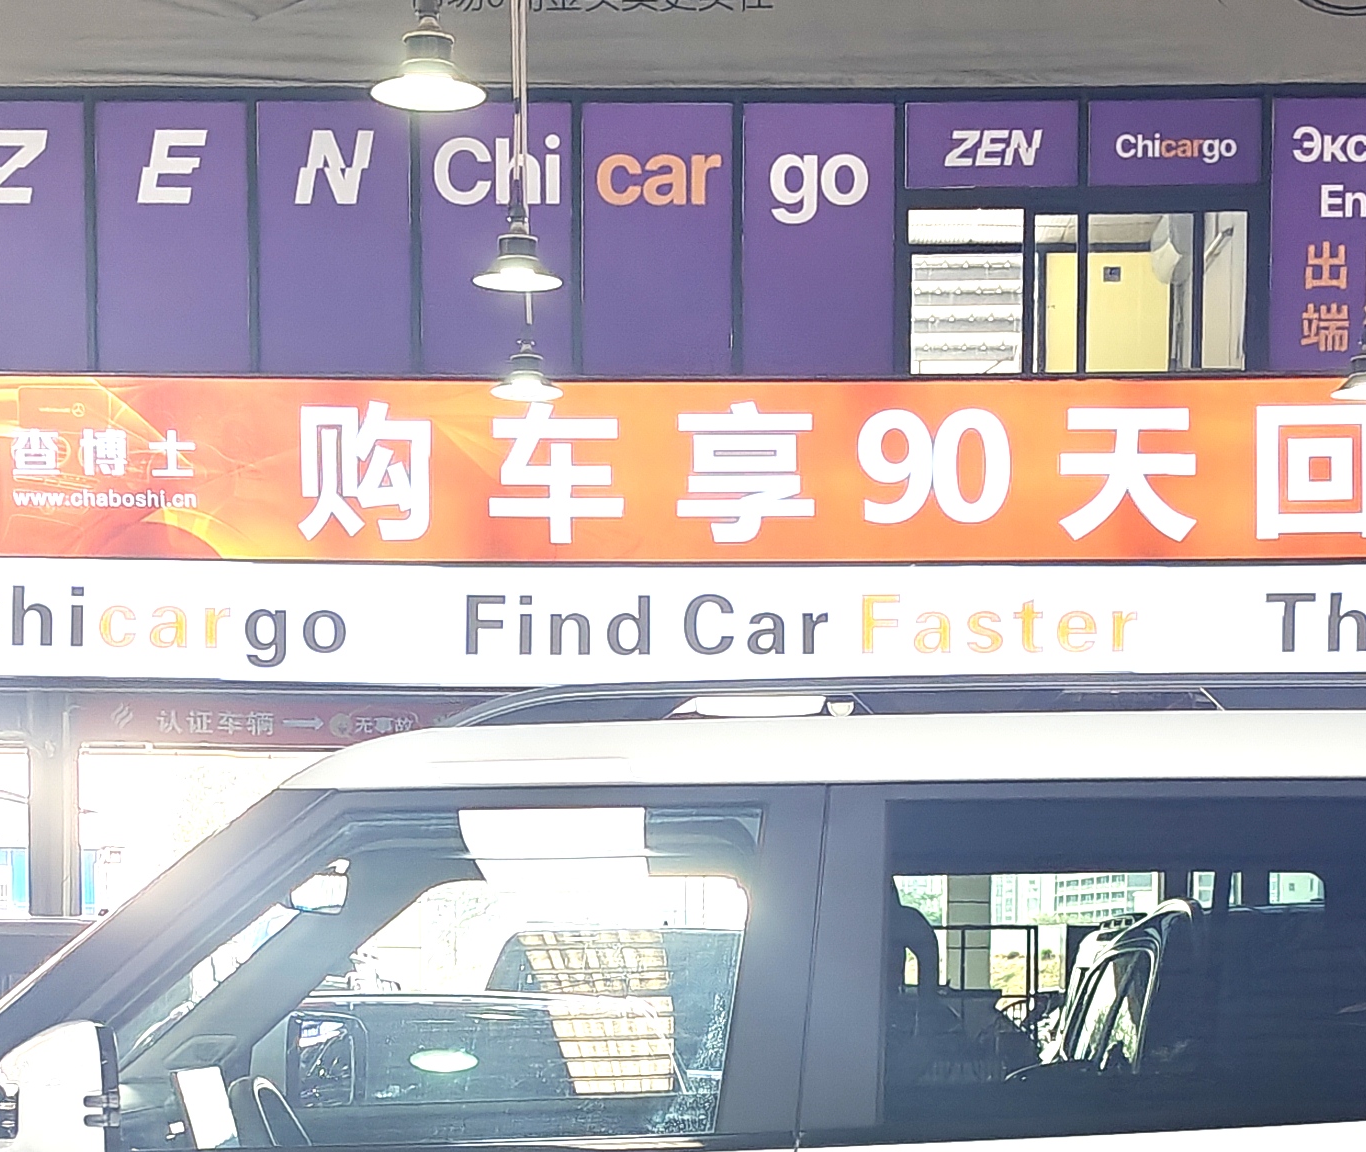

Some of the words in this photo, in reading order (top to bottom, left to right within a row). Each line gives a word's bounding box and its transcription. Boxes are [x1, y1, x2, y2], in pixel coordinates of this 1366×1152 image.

[944, 129, 1044, 167] ZEN
[1115, 133, 1238, 165] Chicargo
[433, 134, 562, 206] Chi
[596, 152, 722, 206] car
[769, 153, 870, 225] go
[11, 428, 196, 478] 查博士
[12, 489, 197, 509] www.chaboshi.cn
[465, 594, 651, 656] Find
[683, 594, 829, 656] Car
[861, 594, 1138, 655] Faster
